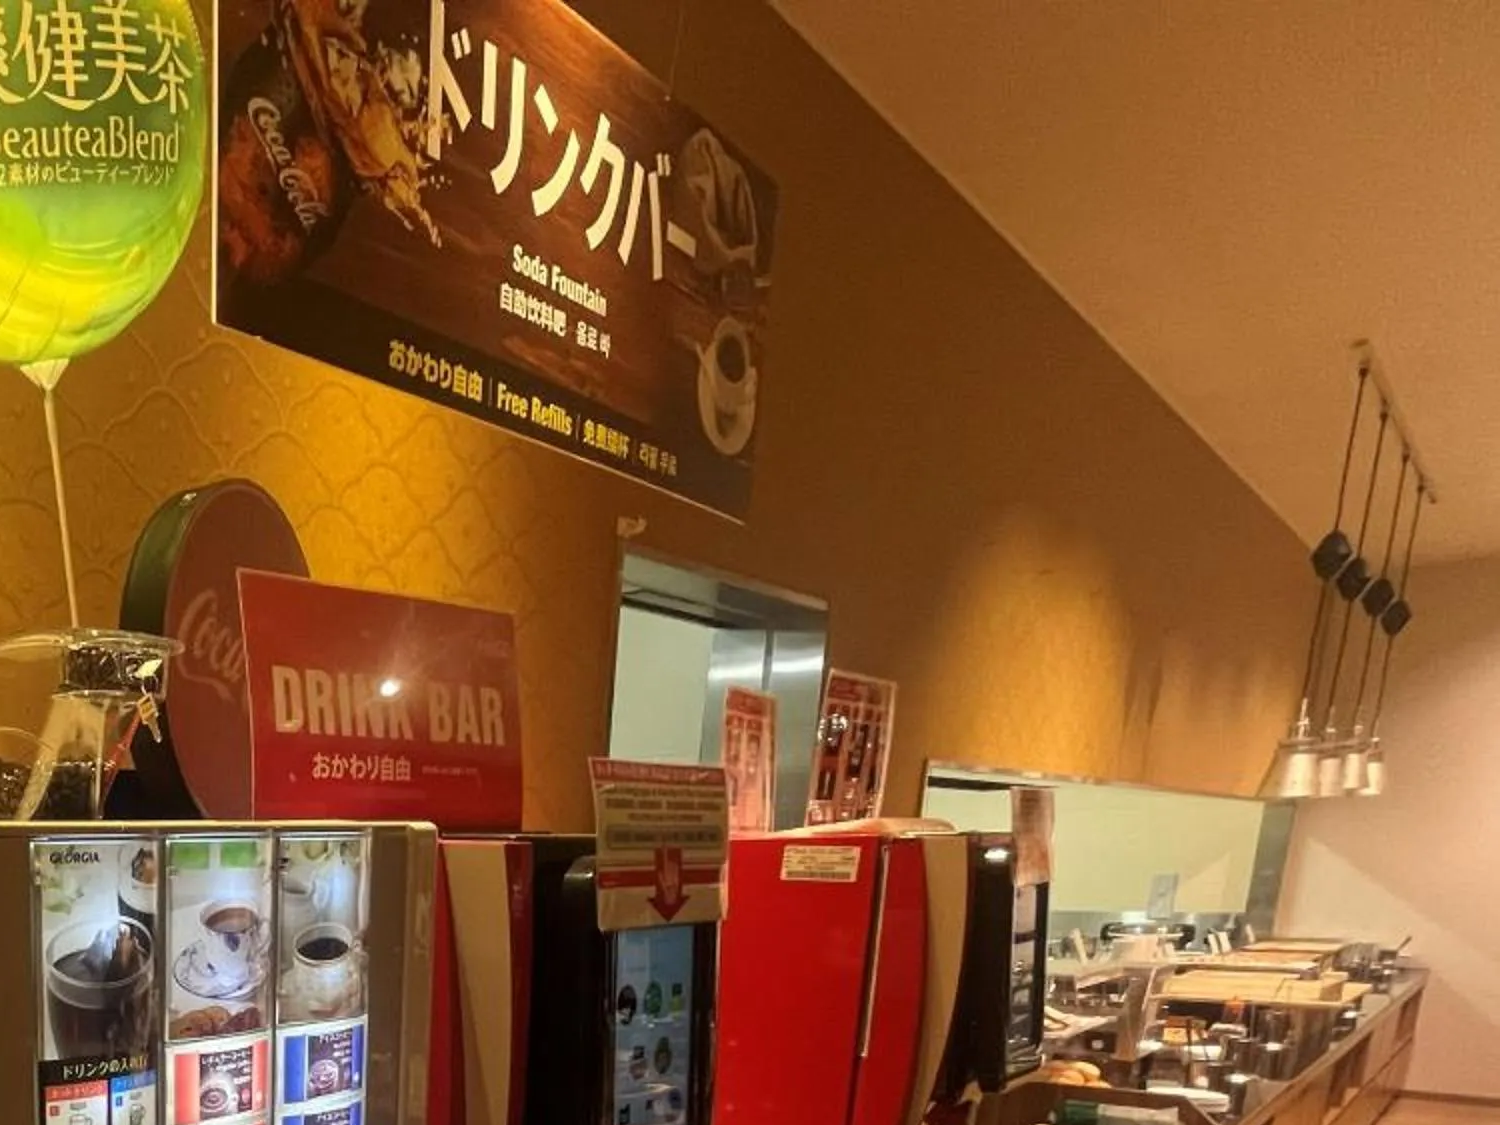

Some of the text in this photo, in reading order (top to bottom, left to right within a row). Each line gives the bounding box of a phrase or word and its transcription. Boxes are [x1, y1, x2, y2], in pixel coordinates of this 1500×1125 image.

[427, 0, 697, 281] ドリンクバー
[512, 244, 607, 317] Soda Fountain
[389, 339, 483, 403] おかわり自由
[497, 382, 573, 437] Free Refills
[272, 664, 506, 747] DRINK BAR
[311, 752, 411, 782] おかわり自由
